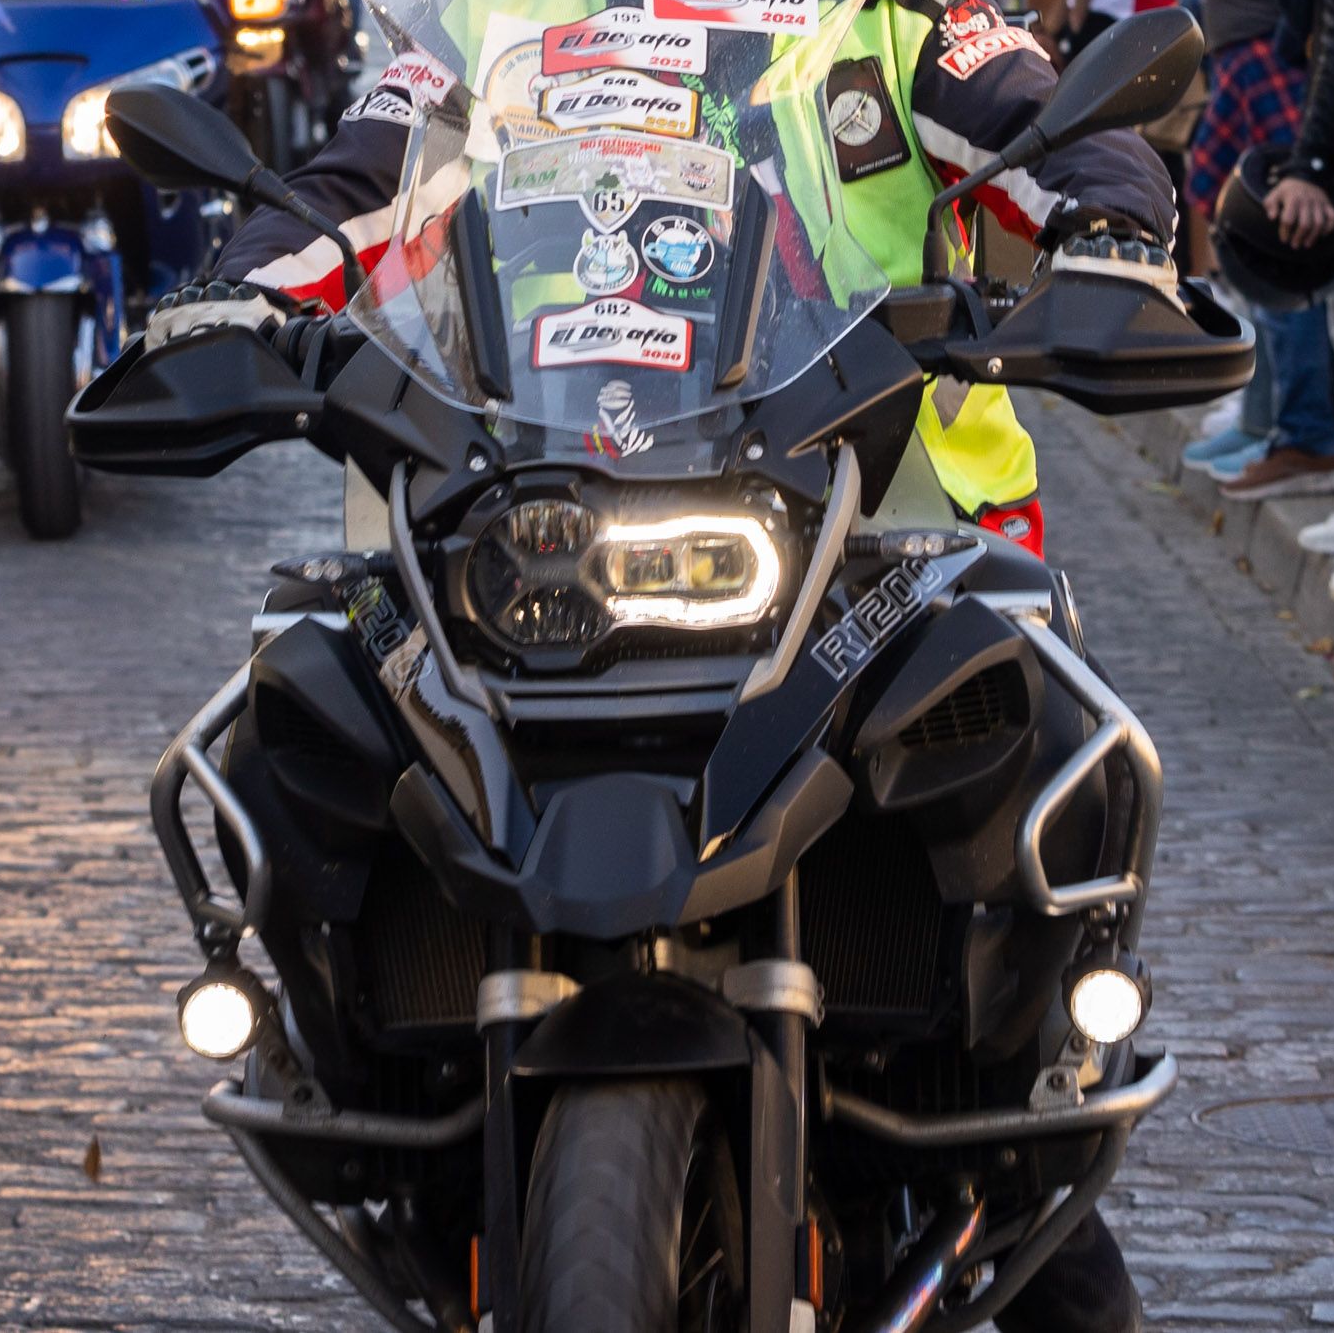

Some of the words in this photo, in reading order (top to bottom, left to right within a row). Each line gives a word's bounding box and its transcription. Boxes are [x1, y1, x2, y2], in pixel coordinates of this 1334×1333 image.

[611, 13, 641, 24] 195
[762, 11, 806, 25] 2024
[558, 32, 586, 50] El
[649, 56, 693, 69] 2022
[603, 76, 639, 87] 646
[554, 96, 580, 115] El
[644, 116, 687, 132] 2021
[510, 168, 559, 188] FAM
[592, 189, 626, 213] 65
[594, 302, 631, 316] 682
[548, 326, 576, 345] El
[642, 349, 682, 361] 2020
[809, 558, 943, 683] R1200
